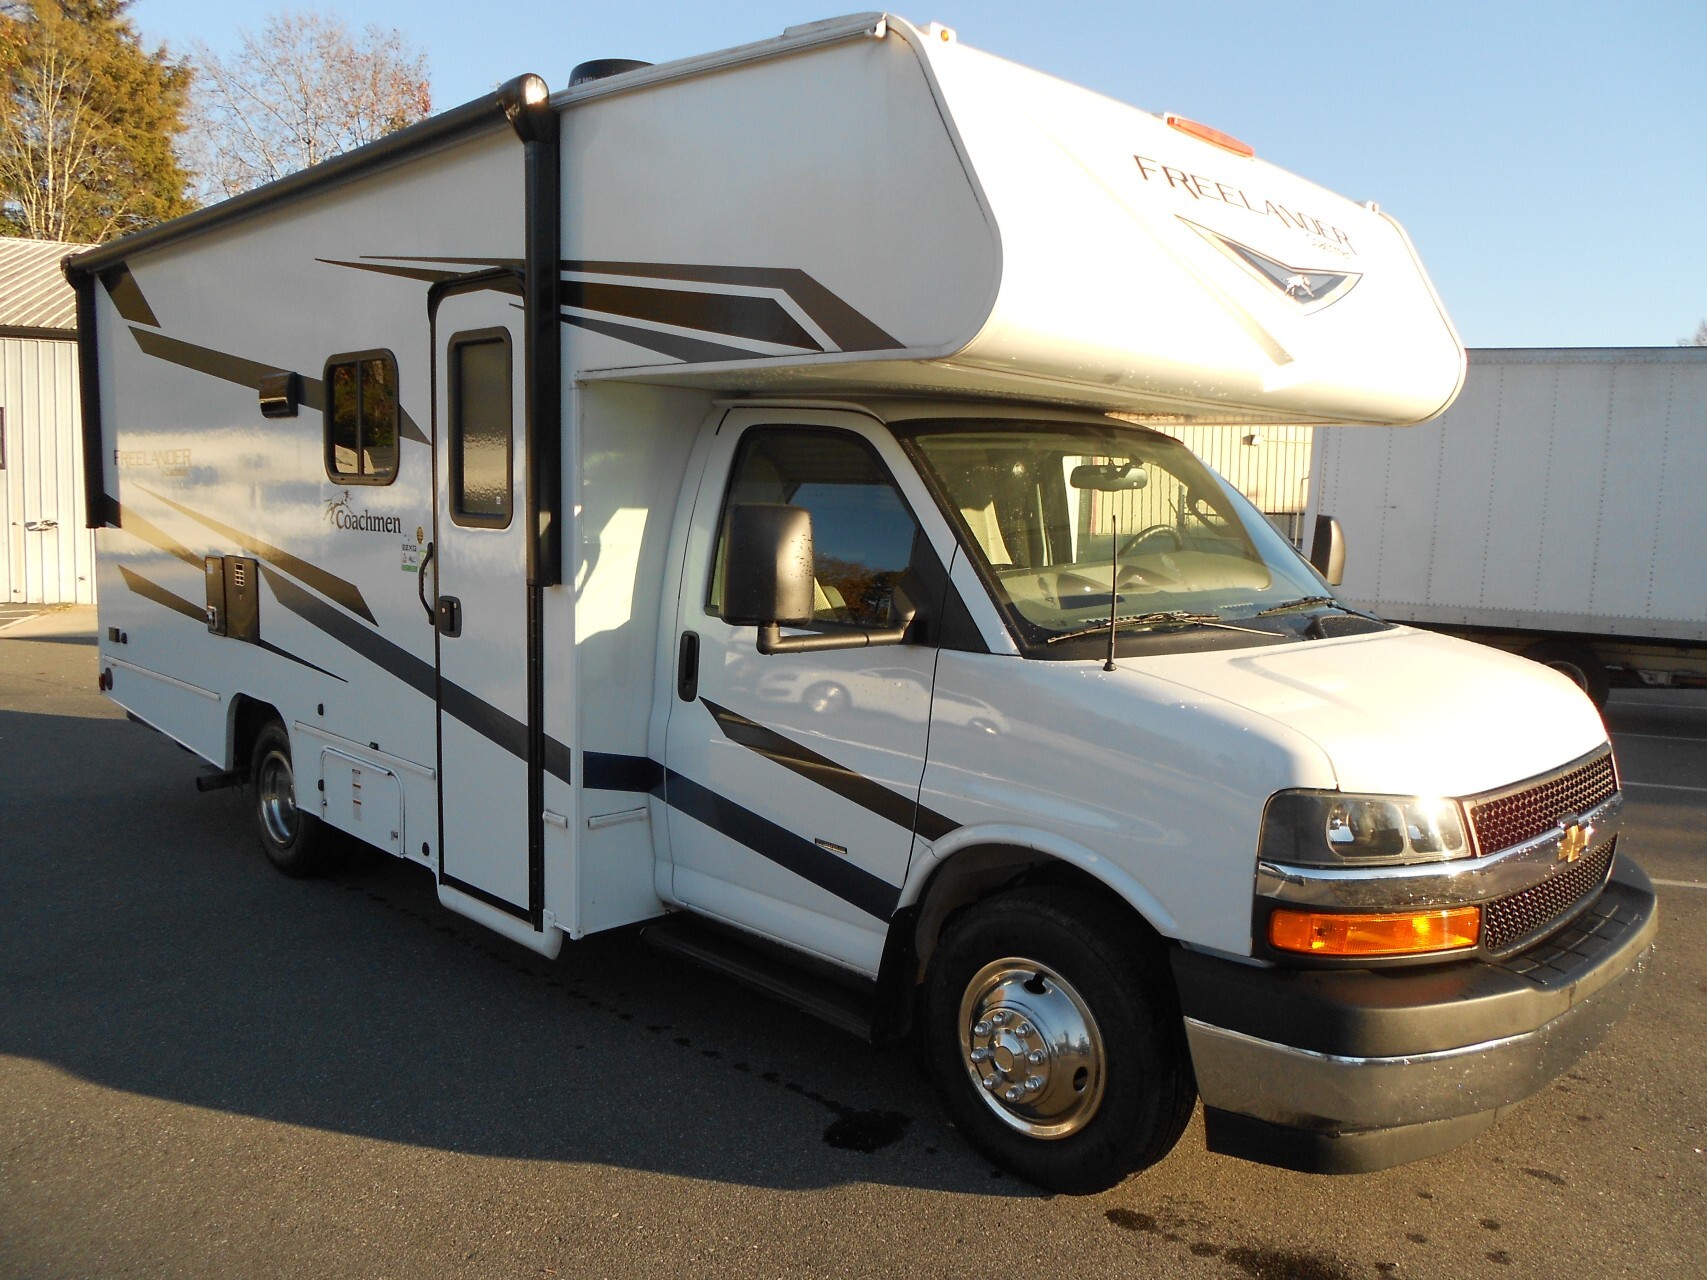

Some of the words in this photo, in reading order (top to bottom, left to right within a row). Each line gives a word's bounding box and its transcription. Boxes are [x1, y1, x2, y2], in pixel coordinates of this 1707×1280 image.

[1133, 154, 1358, 256] FREELANDER
[114, 448, 193, 469] FREELANDER
[336, 509, 401, 533] Coachmen
